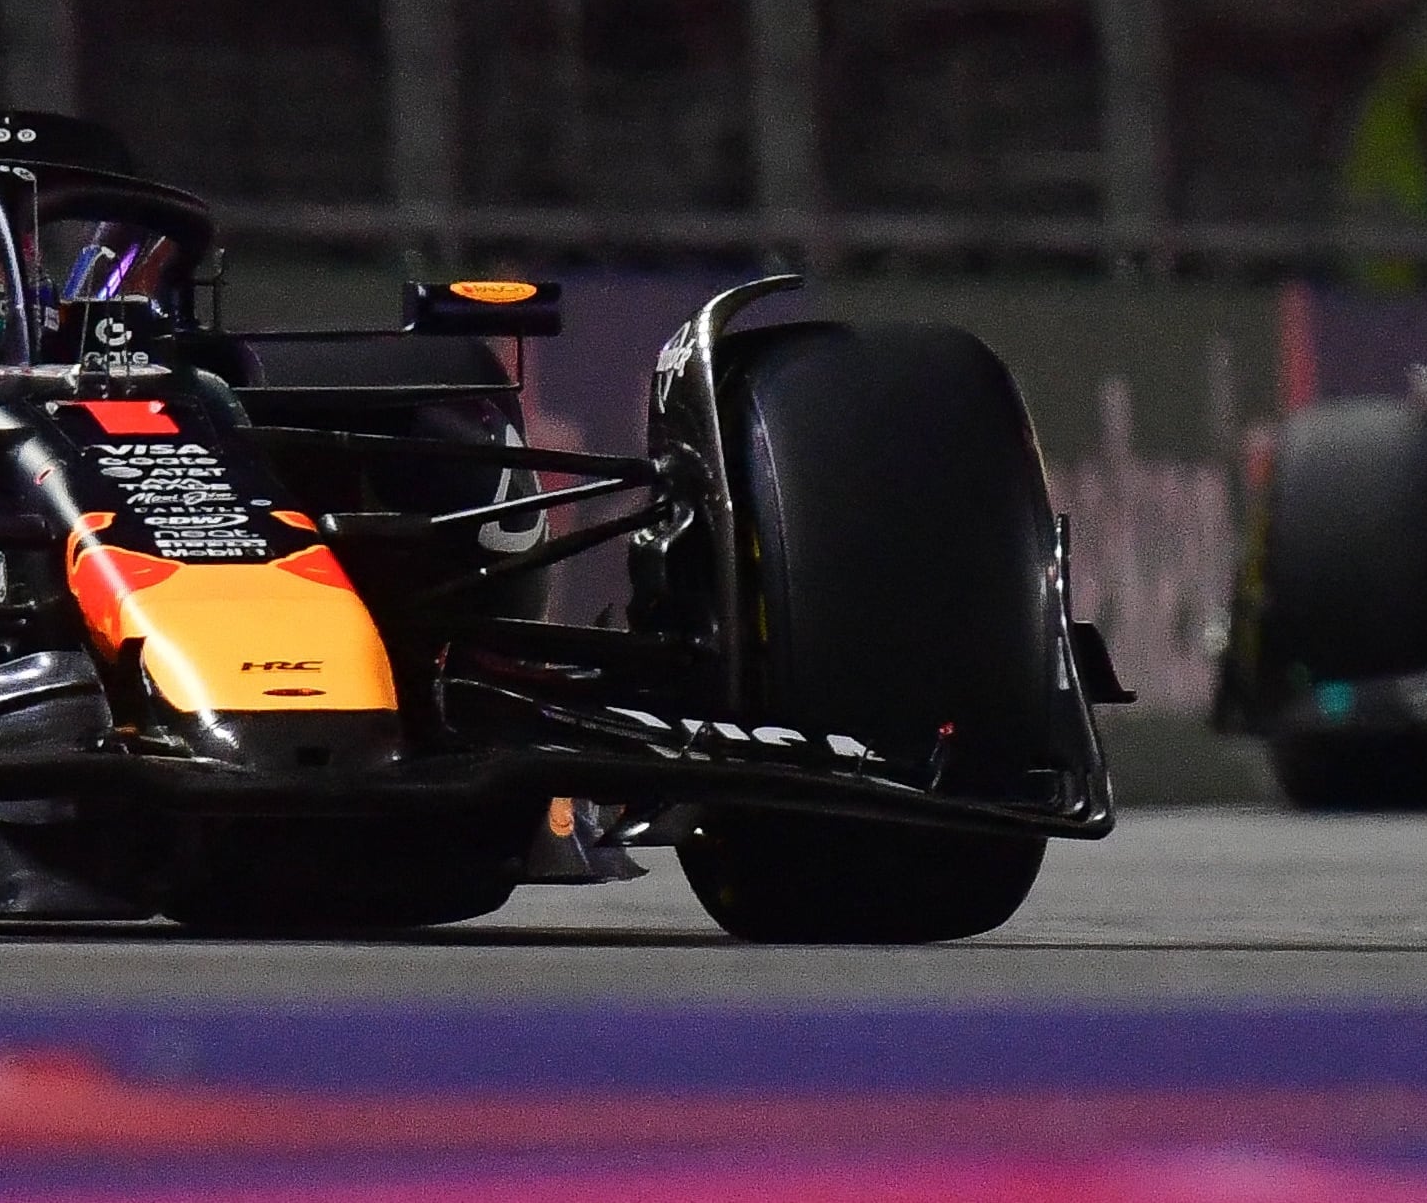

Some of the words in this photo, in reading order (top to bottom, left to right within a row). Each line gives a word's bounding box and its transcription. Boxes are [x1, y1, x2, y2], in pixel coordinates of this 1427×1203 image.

[90, 444, 209, 455] VISA
[150, 468, 226, 477] AT&T
[144, 515, 230, 526] CDW
[161, 548, 243, 557] Mobil
[241, 661, 323, 671] HRC
